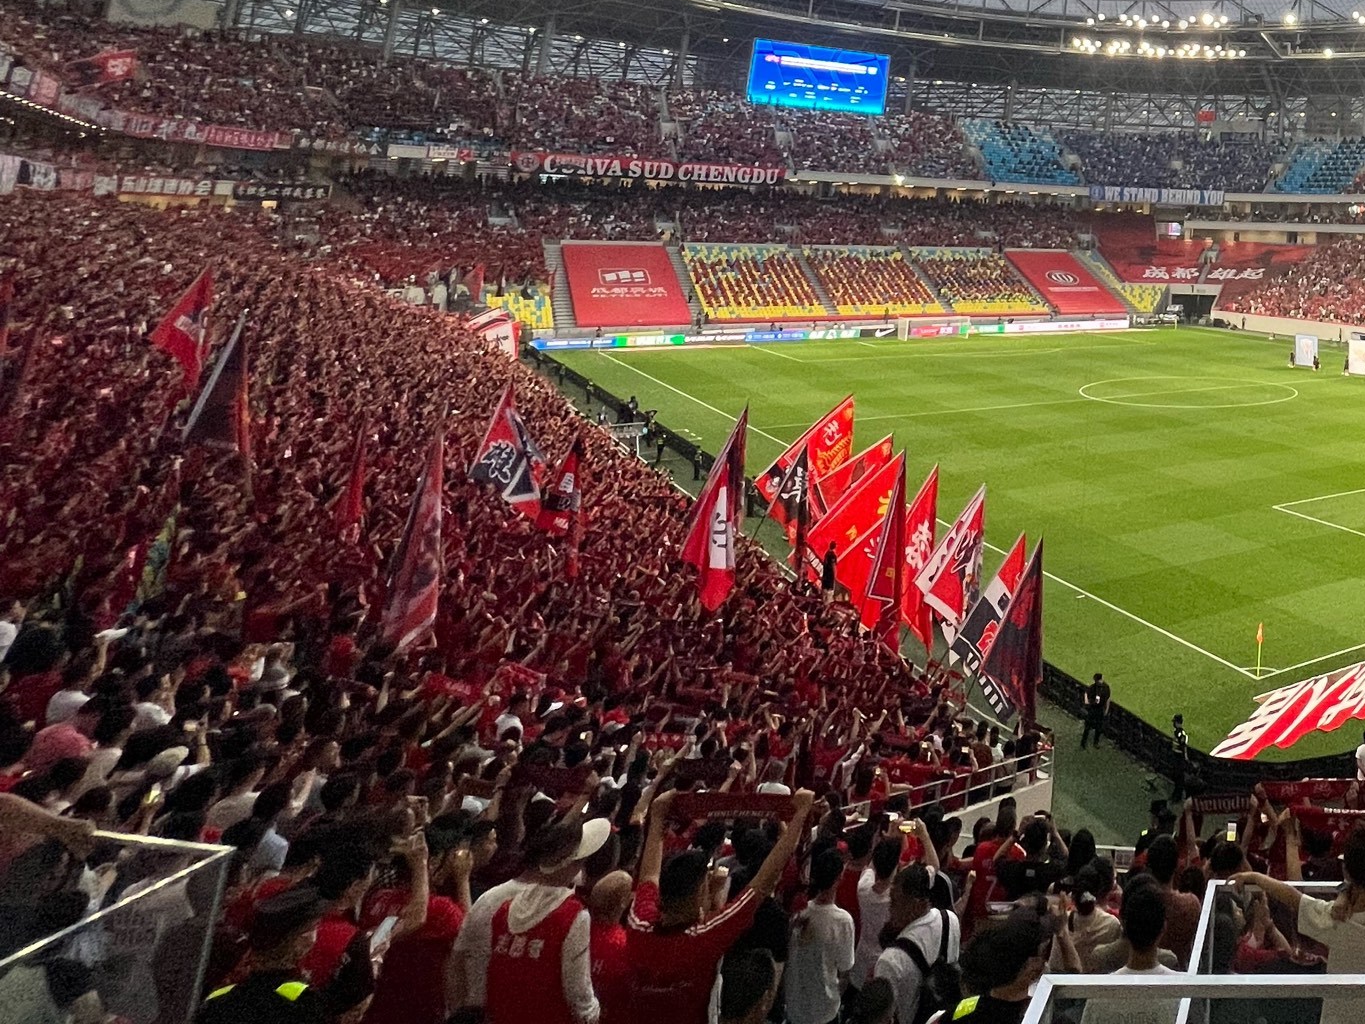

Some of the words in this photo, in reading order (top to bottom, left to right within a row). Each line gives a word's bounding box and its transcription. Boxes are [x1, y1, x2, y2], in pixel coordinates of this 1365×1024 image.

[628, 160, 674, 180] SUD
[678, 163, 780, 185] CHENGDU
[1104, 186, 1121, 202] WE
[1123, 187, 1158, 203] STAND
[1160, 188, 1200, 205] BEHIND
[1203, 190, 1224, 206] YOU
